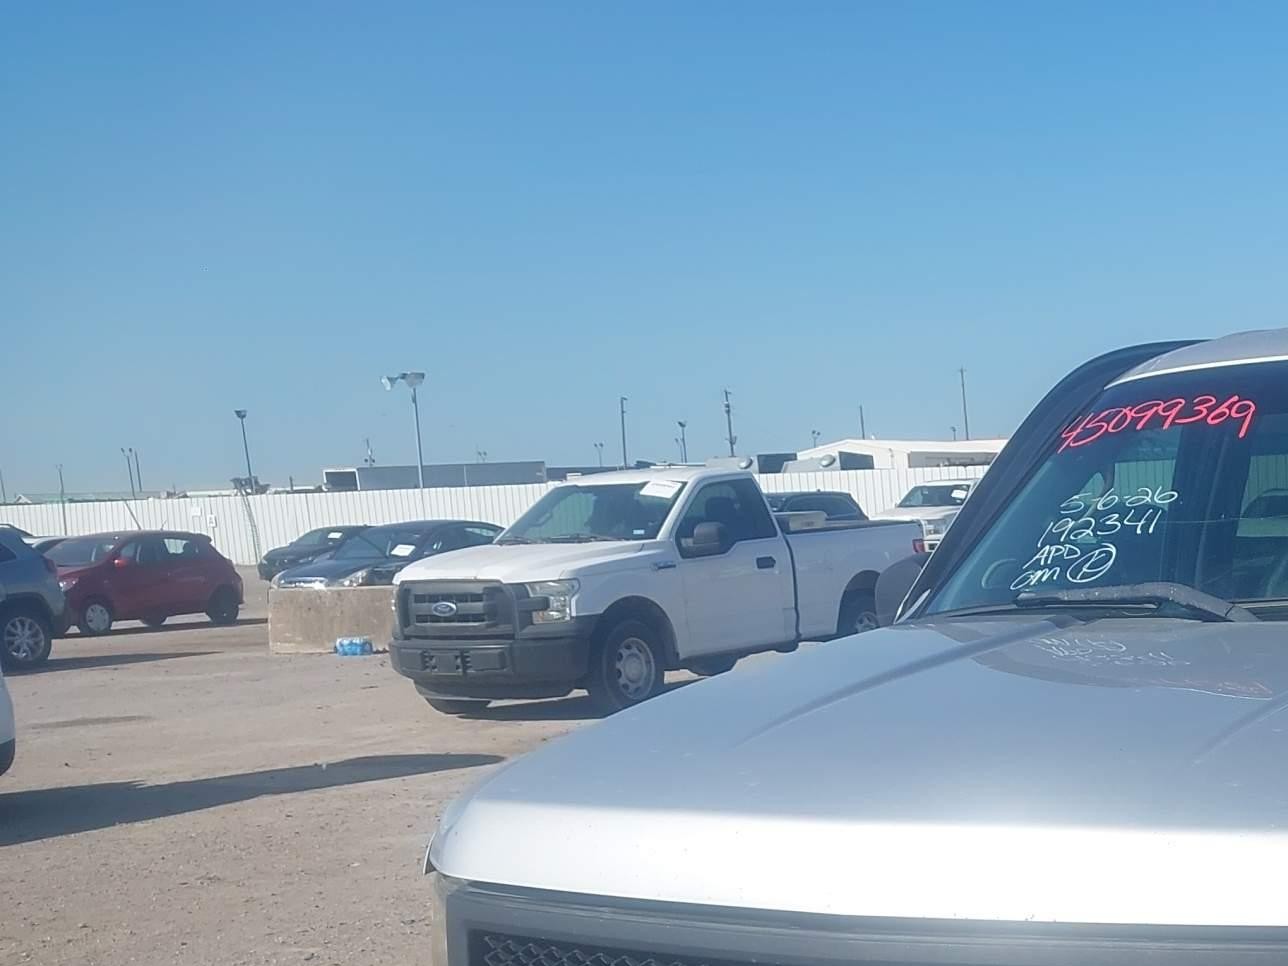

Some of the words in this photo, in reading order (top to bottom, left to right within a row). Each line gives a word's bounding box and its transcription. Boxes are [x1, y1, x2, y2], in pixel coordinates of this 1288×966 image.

[1057, 395, 1256, 454] 45099369
[1060, 486, 1179, 514] 5-6-26
[1037, 508, 1163, 548] 192341
[1022, 544, 1081, 569] APD
